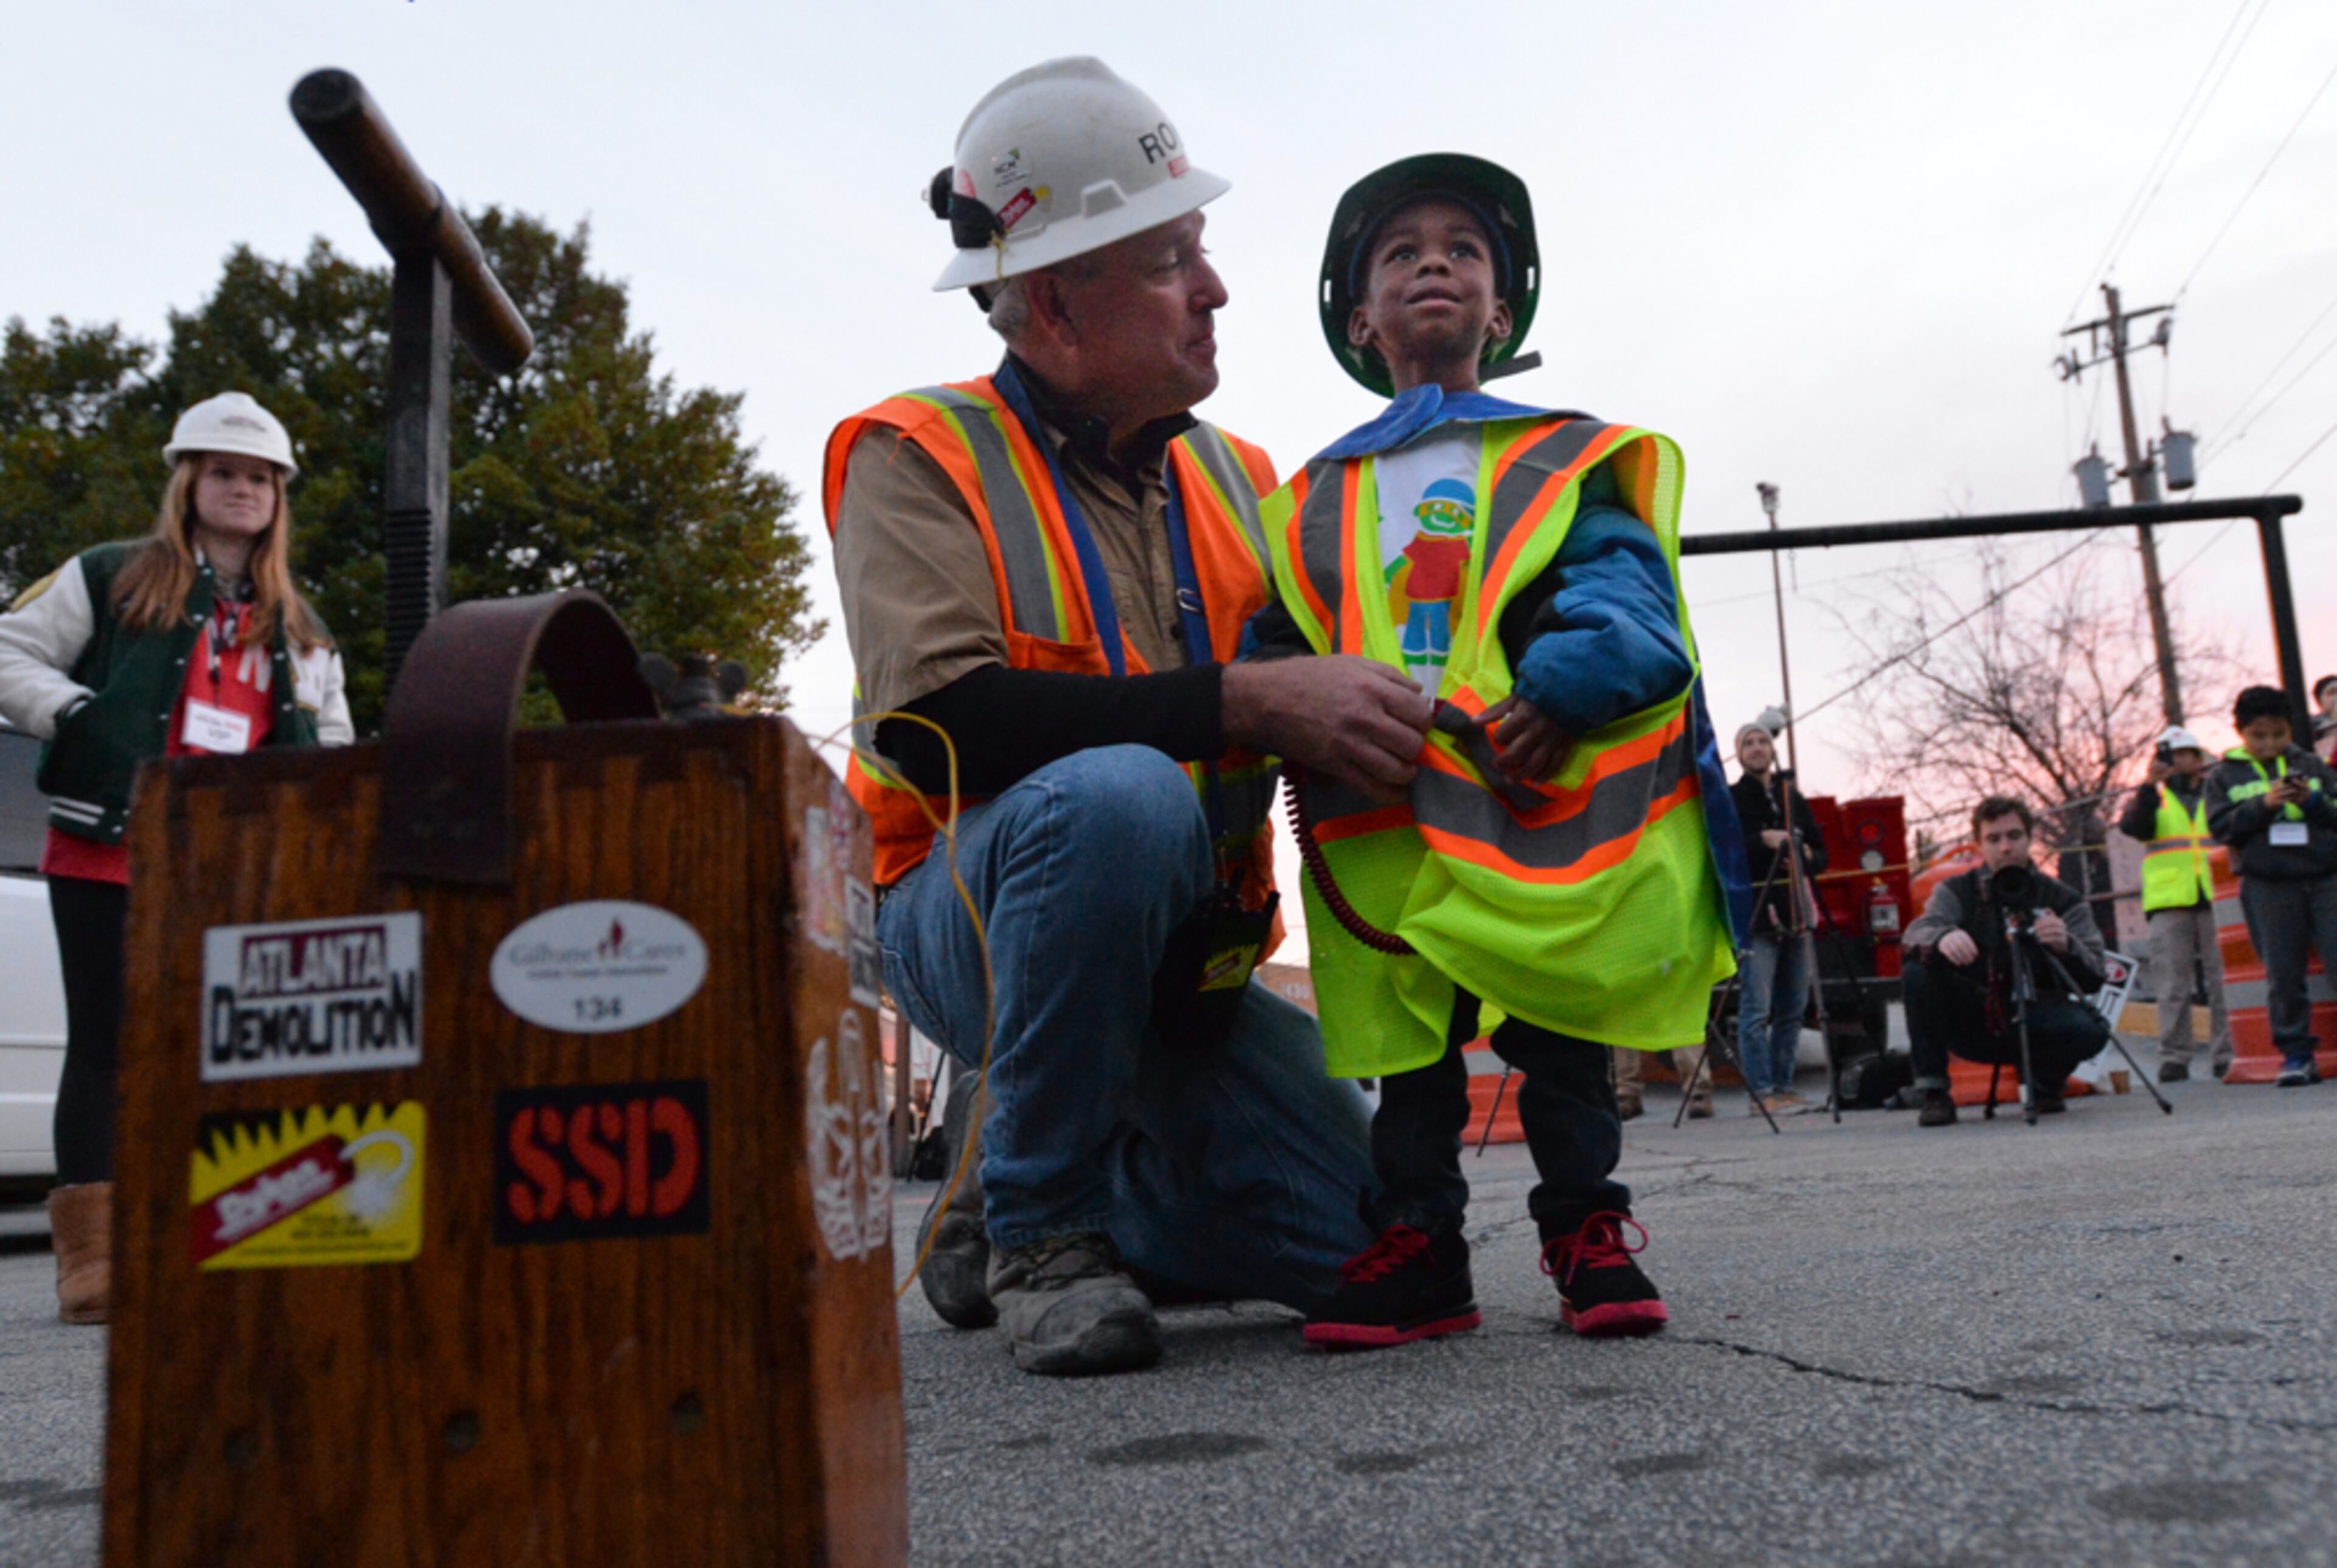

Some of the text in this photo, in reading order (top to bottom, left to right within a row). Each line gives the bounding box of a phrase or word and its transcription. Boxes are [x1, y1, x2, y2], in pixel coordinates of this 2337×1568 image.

[243, 929, 387, 996] ATLANTA
[211, 971, 416, 1064] DEMOLITION
[508, 1096, 699, 1225] SSD
